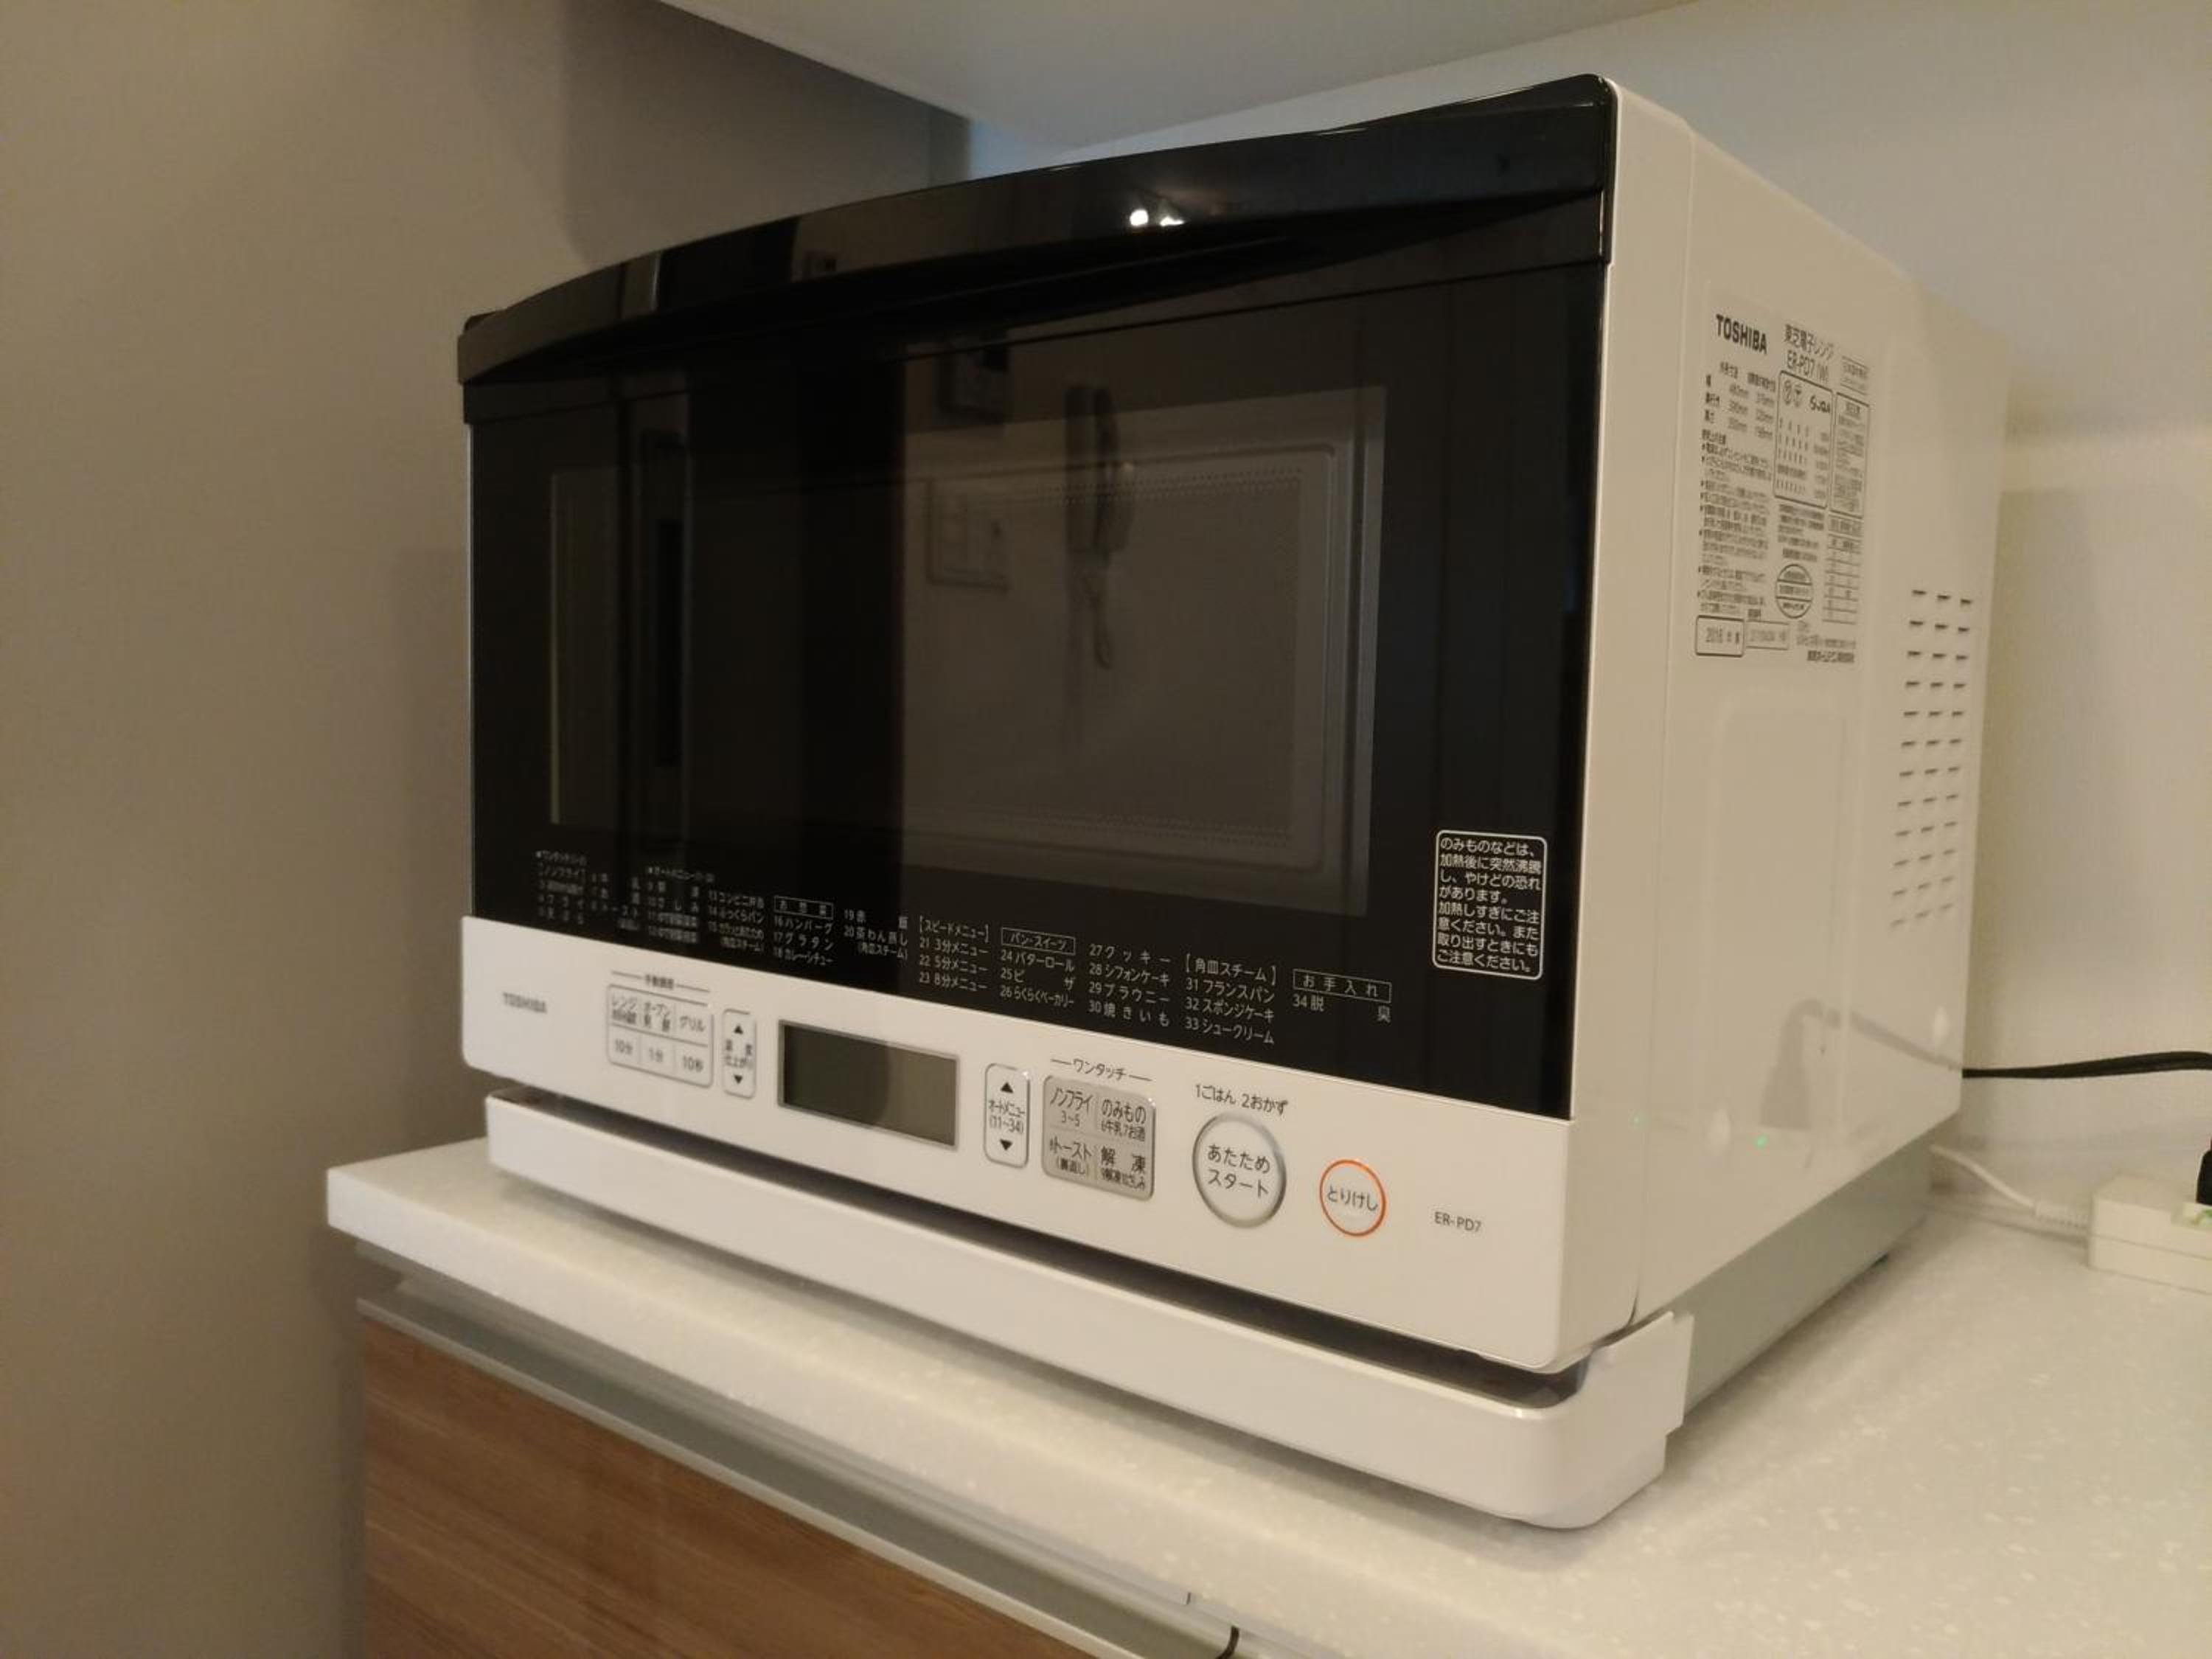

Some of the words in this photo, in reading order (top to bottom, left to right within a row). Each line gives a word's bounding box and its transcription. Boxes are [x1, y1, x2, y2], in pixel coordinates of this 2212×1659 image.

[1716, 313, 1767, 354] TOSHIBA
[1440, 838, 1534, 857] のみものなどは、
[1439, 886, 1508, 905] があります。
[1439, 902, 1540, 925] 加熱しすぎにご注
[1438, 932, 1538, 957] 取り出すときにも
[1438, 948, 1531, 973] ご注意ください。
[1073, 1058, 1126, 1081] ワンタッチ
[1050, 1088, 1093, 1115] ノンフライ
[1102, 1099, 1147, 1124] のみもの
[1207, 1144, 1271, 1174] あたため
[1207, 1168, 1269, 1198] スタート
[1326, 1185, 1378, 1211] とりけし
[1435, 1211, 1482, 1233] ER-PD7
